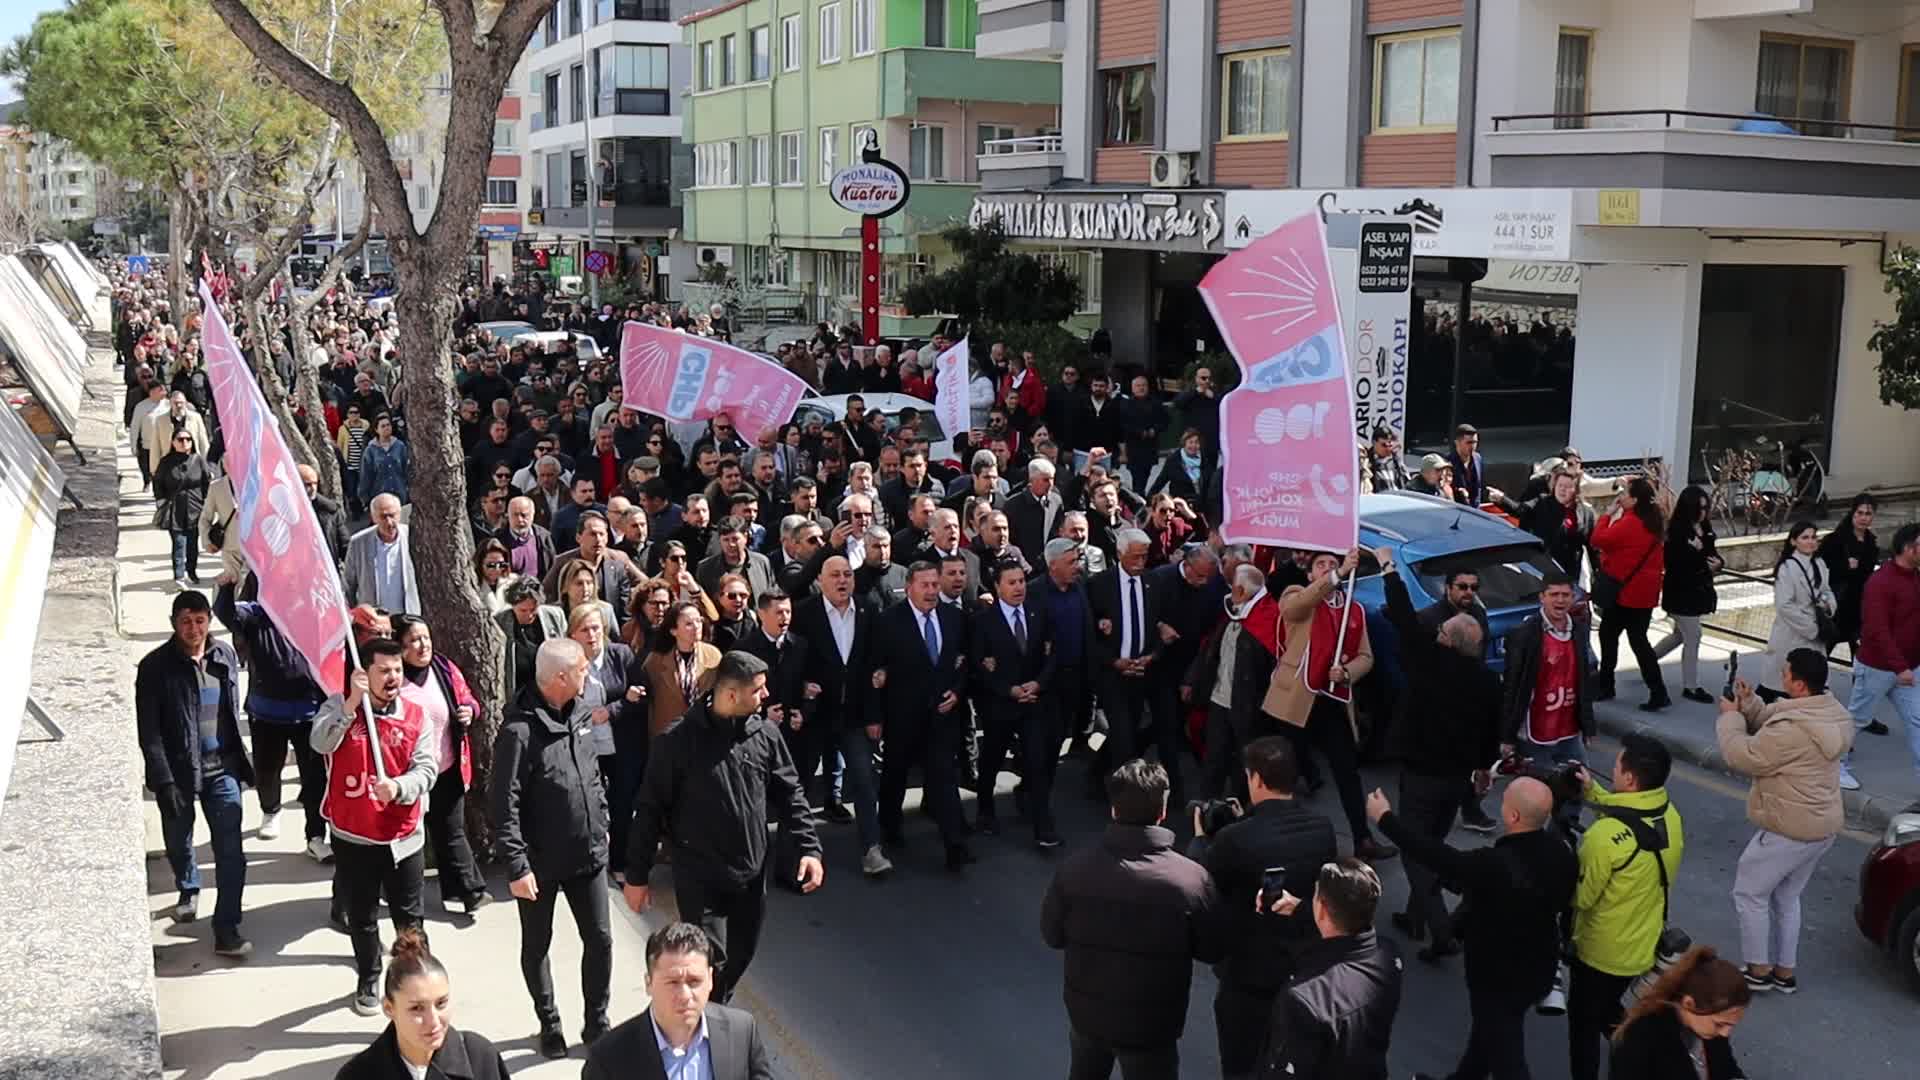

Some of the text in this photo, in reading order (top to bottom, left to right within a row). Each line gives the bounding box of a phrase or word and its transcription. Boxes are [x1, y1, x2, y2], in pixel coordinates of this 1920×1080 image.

[1364, 232, 1409, 243] ASEL YAPI
[1495, 226, 1515, 238] 444
[1530, 225, 1554, 240] SUR
[1369, 245, 1404, 260] İNŞAAT
